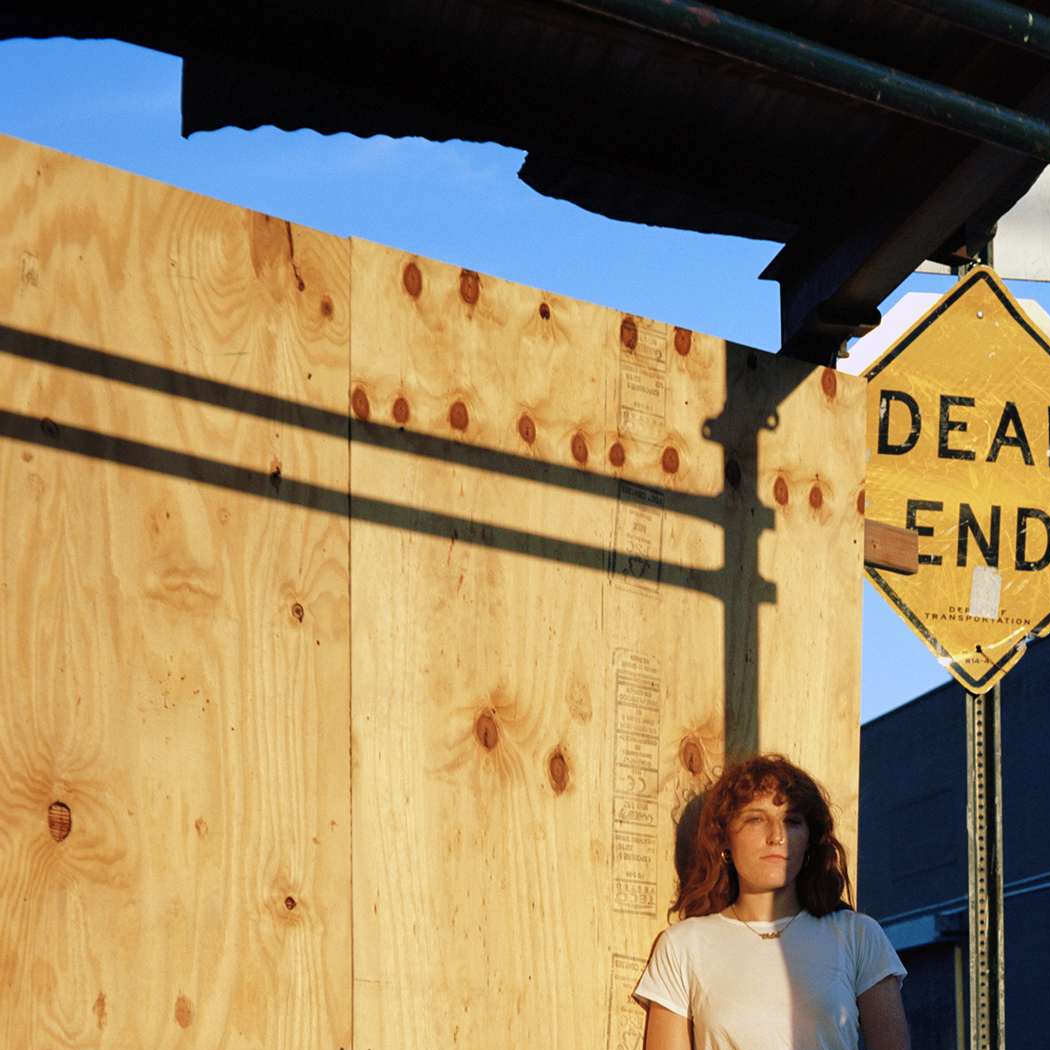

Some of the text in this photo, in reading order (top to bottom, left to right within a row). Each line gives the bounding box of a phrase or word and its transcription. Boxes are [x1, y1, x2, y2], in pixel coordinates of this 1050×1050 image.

[631, 383, 659, 396] EXPOSURE
[655, 380, 664, 389] 1/2
[633, 521, 646, 533] MIX
[619, 693, 645, 704] PLYWOOD
[624, 801, 635, 809] 352
[624, 852, 651, 862] EXPOSURE
[615, 891, 655, 905] TECO
